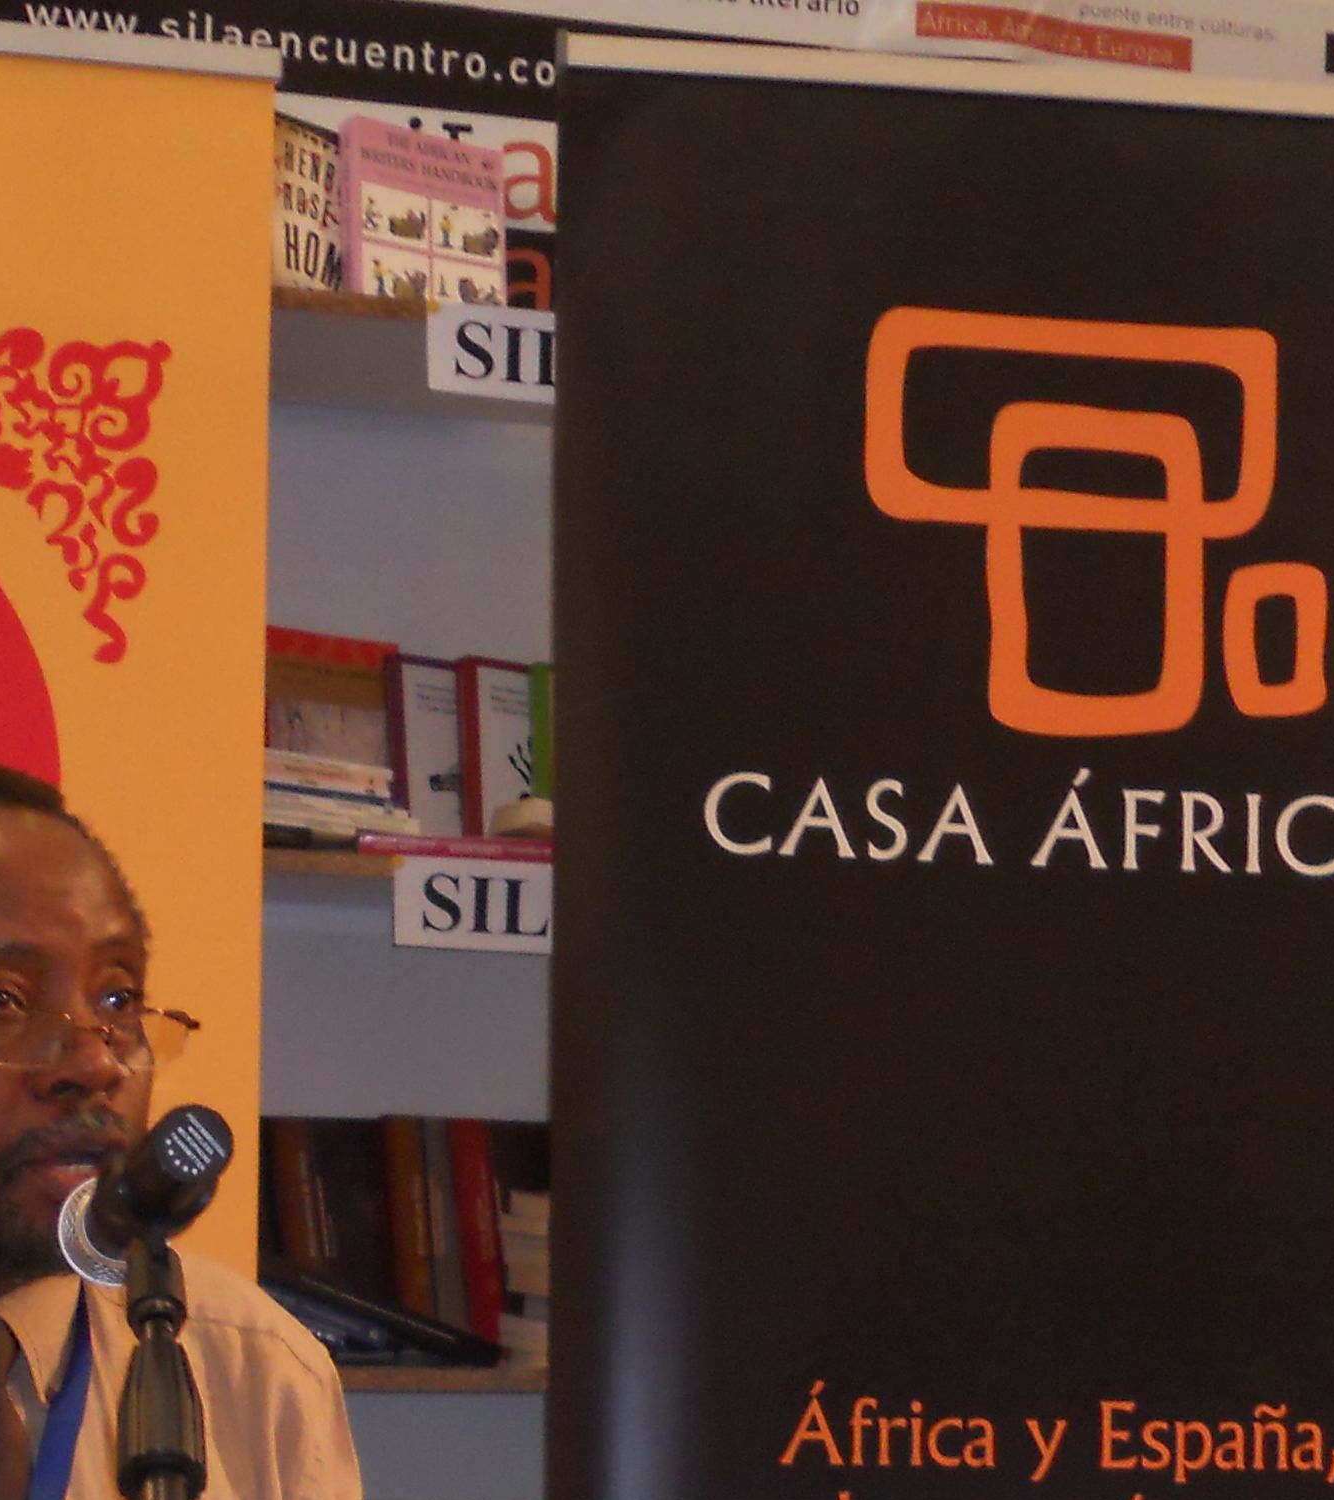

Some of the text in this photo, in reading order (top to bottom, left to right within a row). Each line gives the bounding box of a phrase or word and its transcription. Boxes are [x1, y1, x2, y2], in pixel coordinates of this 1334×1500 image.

[703, 771, 995, 867] CASA
[778, 1380, 997, 1469] África
[1024, 1418, 1066, 1482] y
